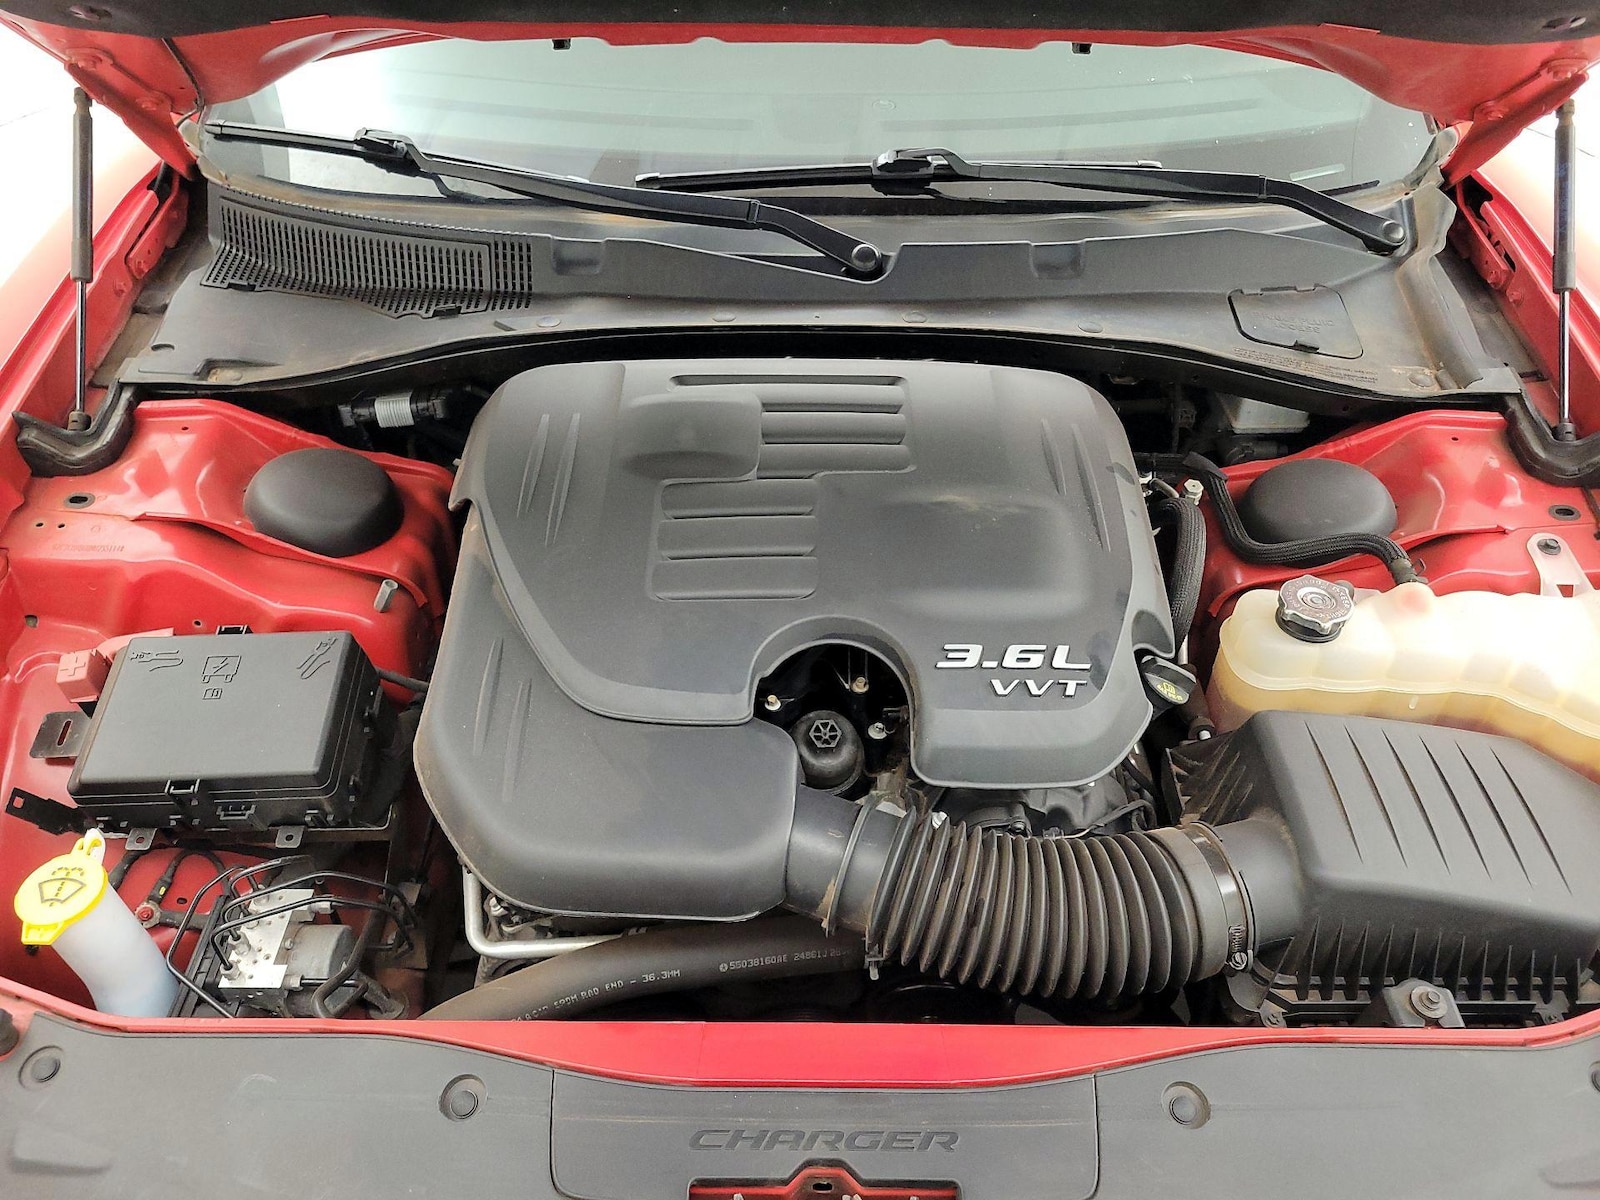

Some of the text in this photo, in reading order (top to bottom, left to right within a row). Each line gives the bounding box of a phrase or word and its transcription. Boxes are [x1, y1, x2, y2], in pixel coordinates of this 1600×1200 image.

[935, 643, 1092, 670] 3.6L
[990, 679, 1088, 697] VVT
[605, 979, 624, 992] END
[688, 1129, 959, 1151] CHARGER
